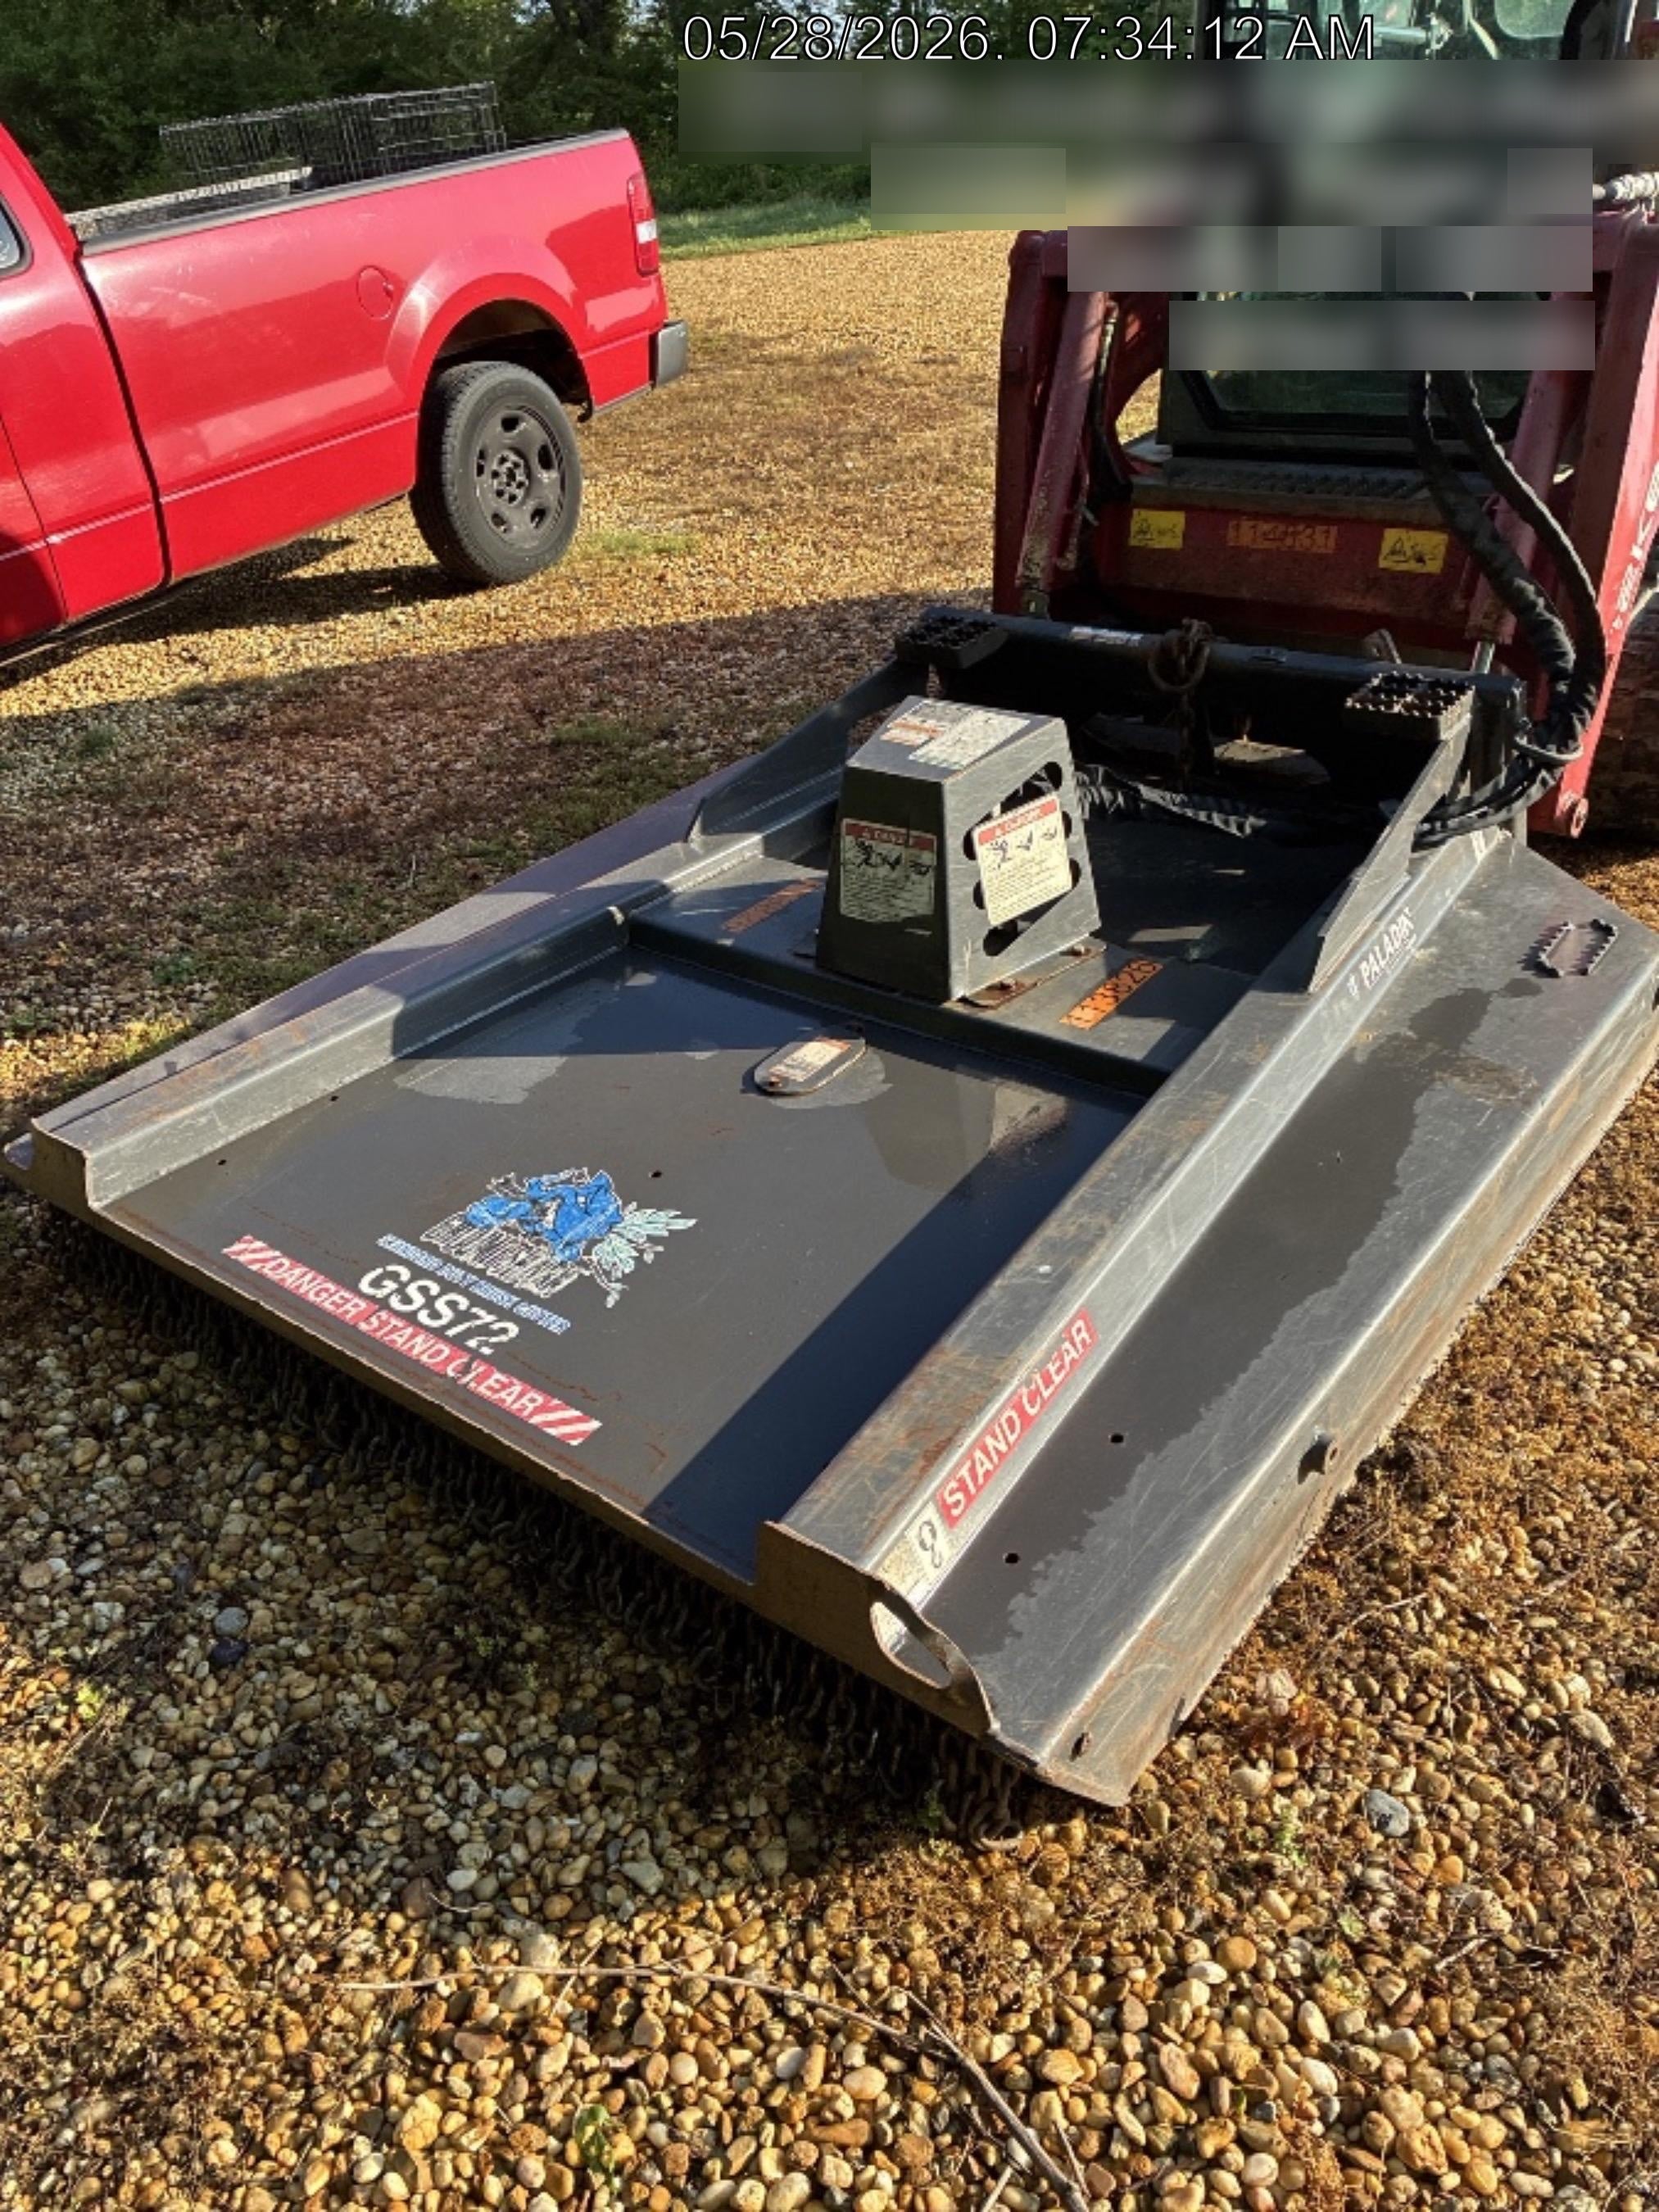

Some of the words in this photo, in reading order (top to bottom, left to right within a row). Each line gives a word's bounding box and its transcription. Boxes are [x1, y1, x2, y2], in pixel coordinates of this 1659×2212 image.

[262, 1256, 367, 1317] DANGER
[358, 1309, 451, 1363] STAND
[446, 1353, 543, 1417] CLEAR
[358, 1264, 519, 1355] GSS72
[944, 1407, 1022, 1517] STAND
[1021, 1318, 1093, 1416] CLEAR
